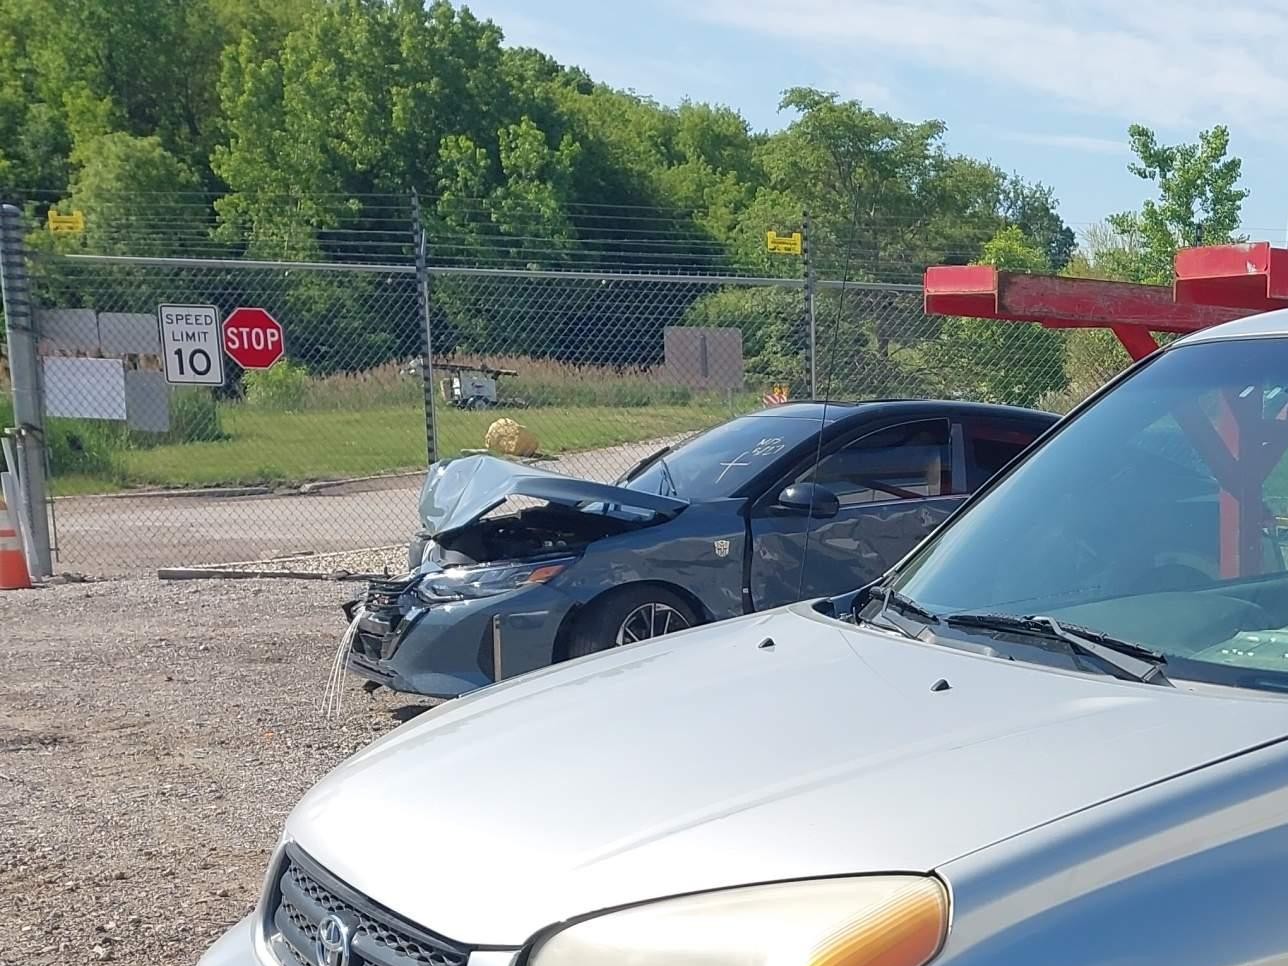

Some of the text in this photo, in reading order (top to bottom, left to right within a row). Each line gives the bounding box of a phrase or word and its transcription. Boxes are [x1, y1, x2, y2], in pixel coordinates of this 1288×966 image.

[165, 313, 213, 326] SPEED
[171, 331, 209, 343] LIMIT
[226, 327, 279, 350] STOP
[174, 348, 212, 376] 10
